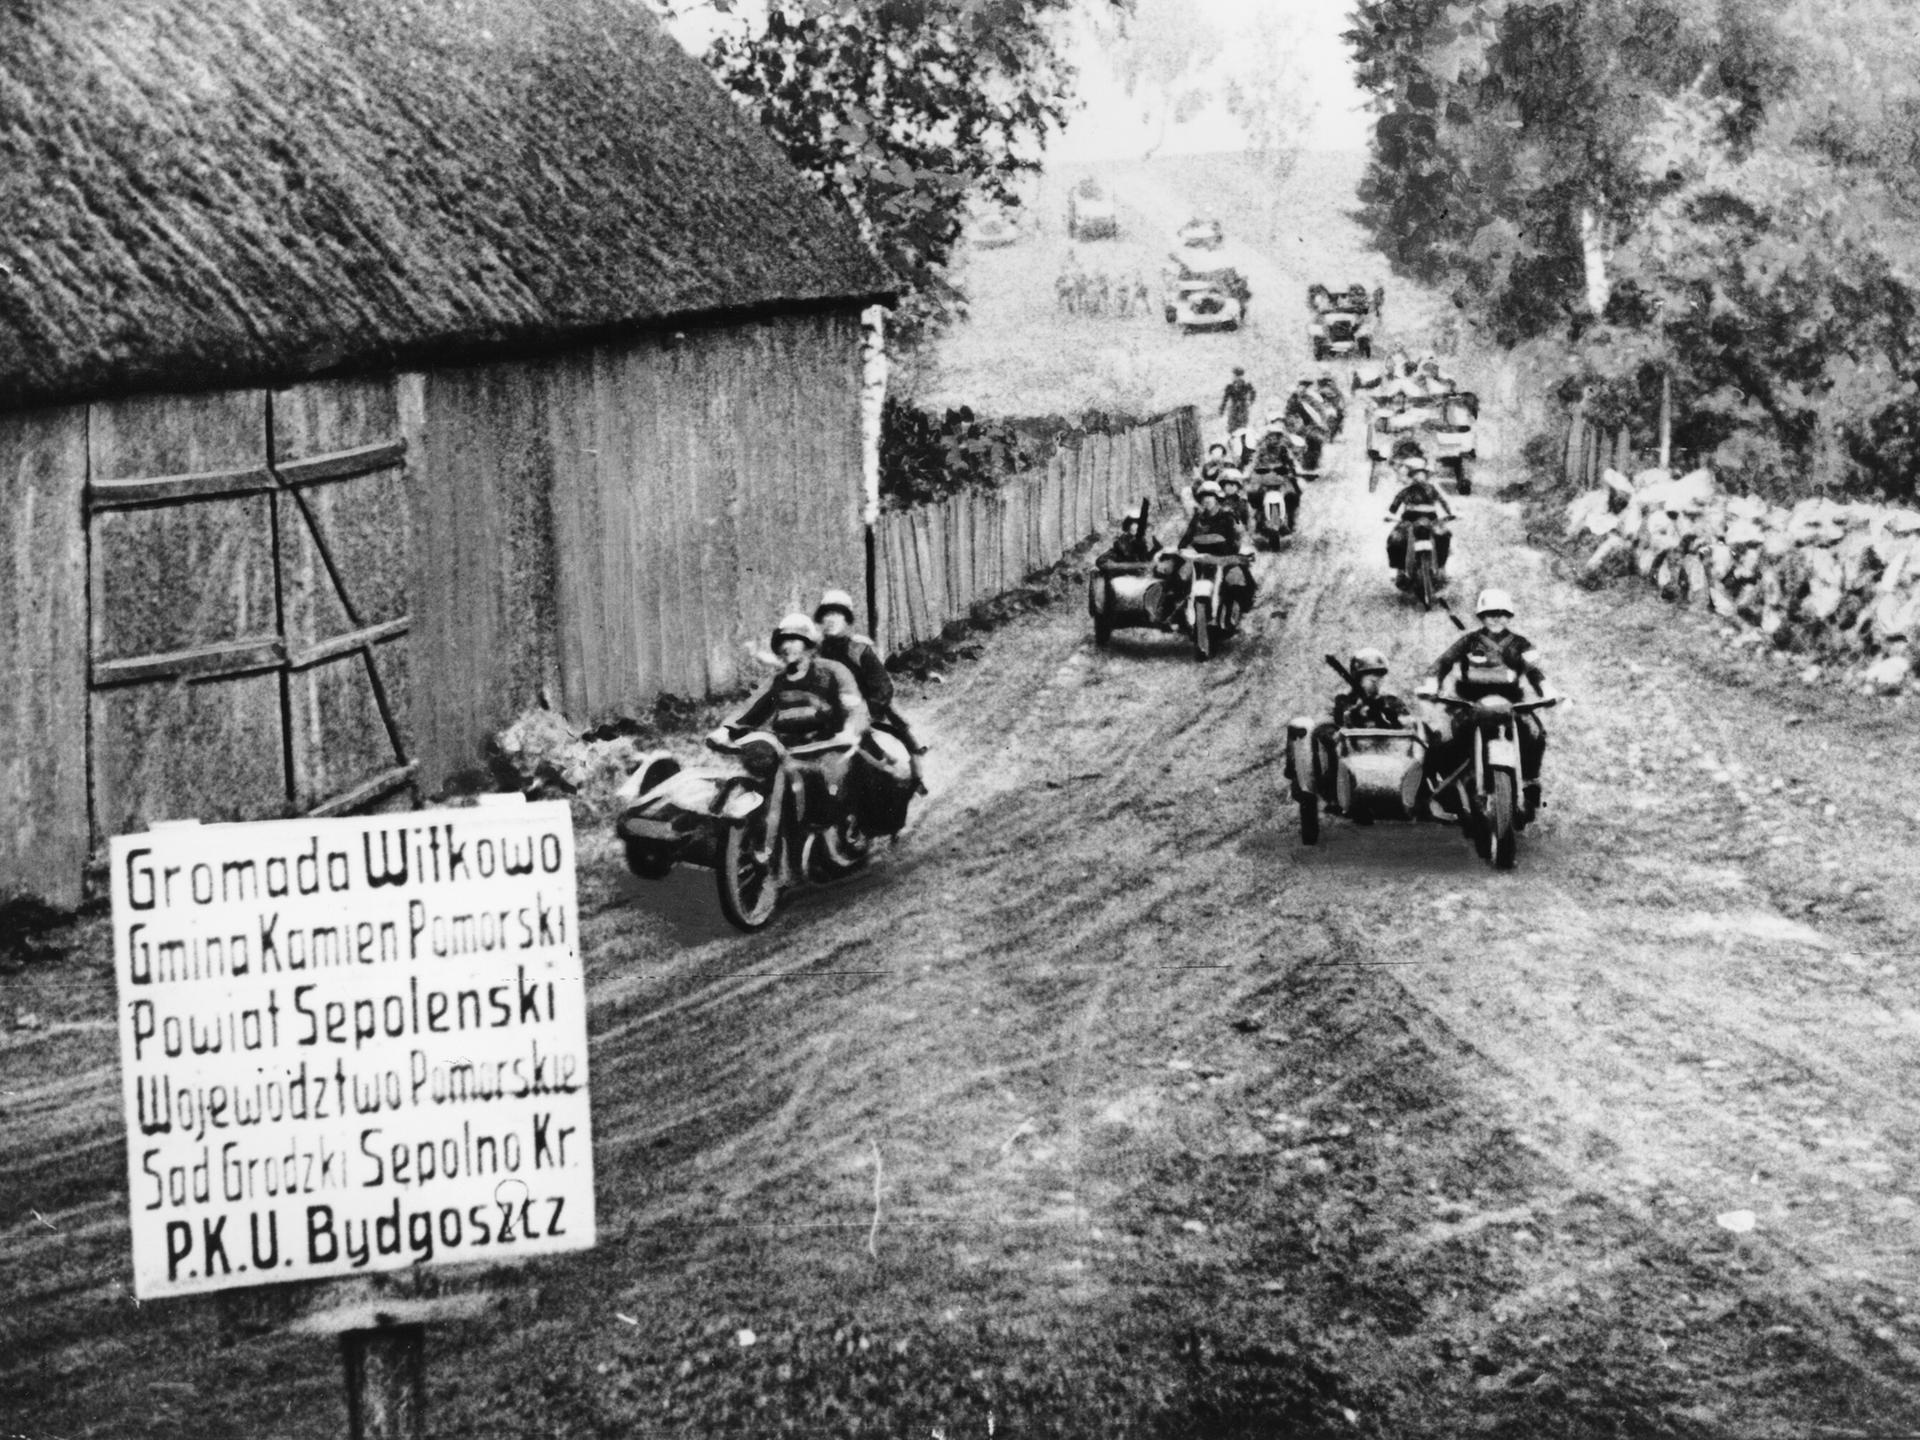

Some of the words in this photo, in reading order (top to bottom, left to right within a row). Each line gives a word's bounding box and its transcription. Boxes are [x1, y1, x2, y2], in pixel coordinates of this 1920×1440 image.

[127, 836, 349, 911] Gromada
[363, 824, 562, 888] Witkowo
[129, 923, 249, 985] Gmina
[259, 911, 398, 974] Kamien
[409, 892, 567, 959] Pomorski
[134, 989, 280, 1061] Powiat
[294, 961, 556, 1050] Sepolenski
[411, 1039, 580, 1105] Pomorskie
[142, 1146, 211, 1211] Sad
[222, 1135, 348, 1201] Grodzki
[360, 1120, 521, 1191] Sepolno
[166, 1209, 293, 1282] P.K.U.
[307, 1197, 566, 1268] Bydgoszcz
